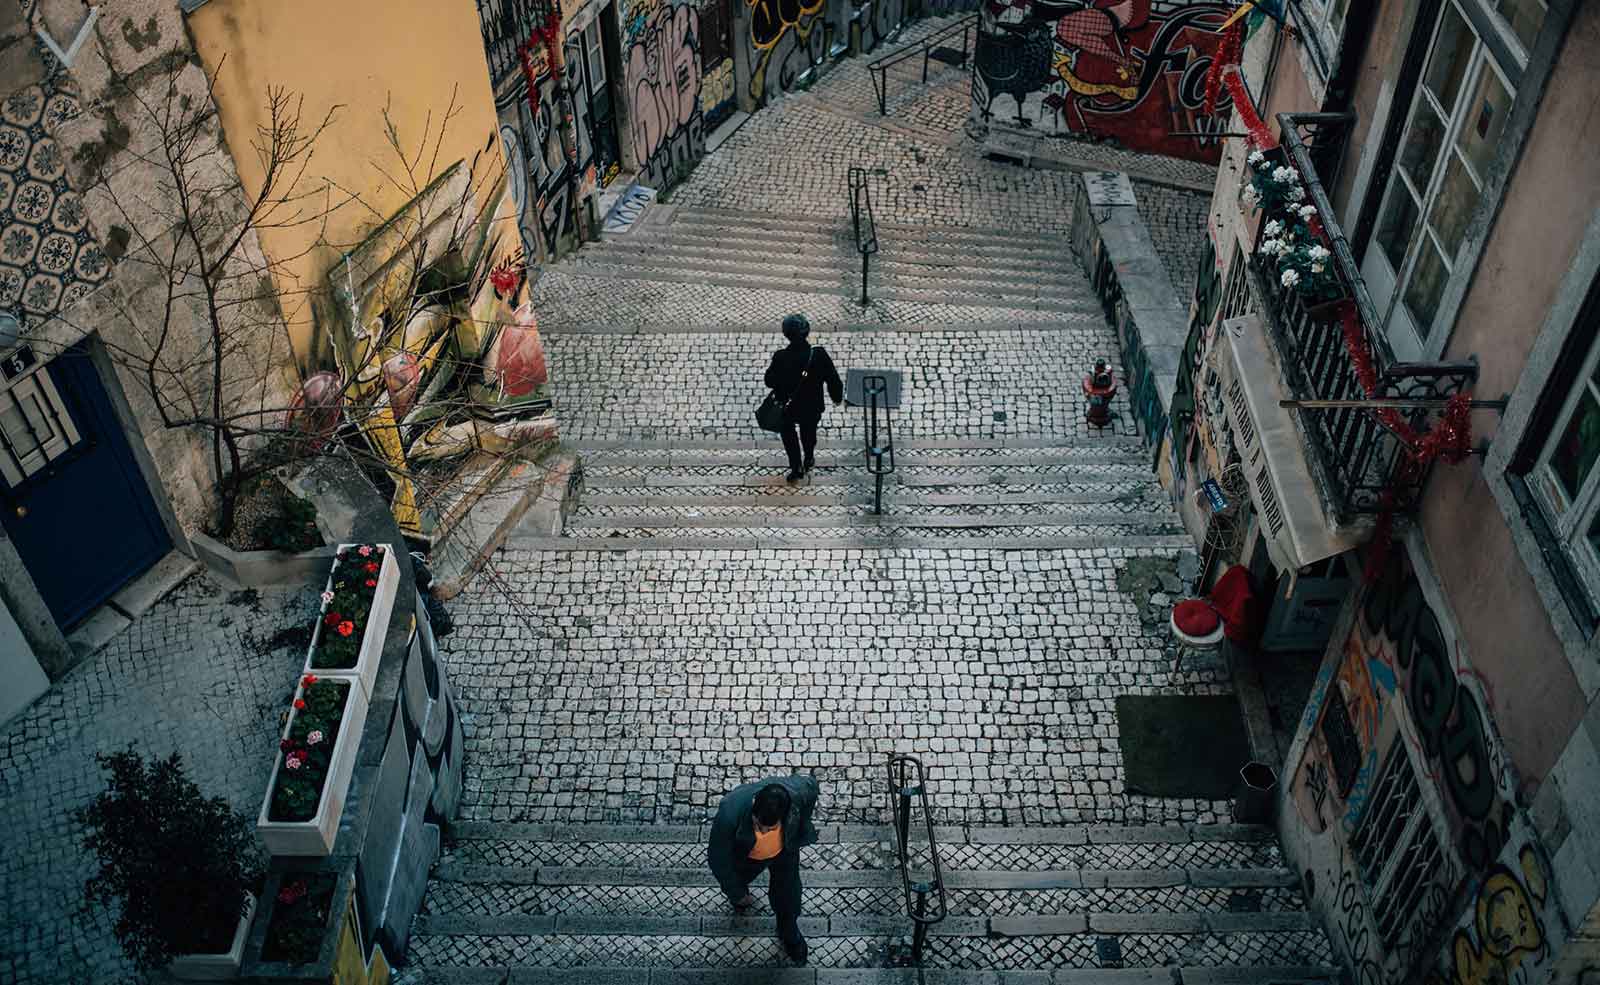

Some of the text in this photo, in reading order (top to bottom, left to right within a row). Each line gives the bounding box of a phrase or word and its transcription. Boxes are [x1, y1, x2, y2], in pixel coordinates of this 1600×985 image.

[10, 353, 25, 372] 5
[1230, 379, 1283, 540] CAFETARIA A MOURARIA
